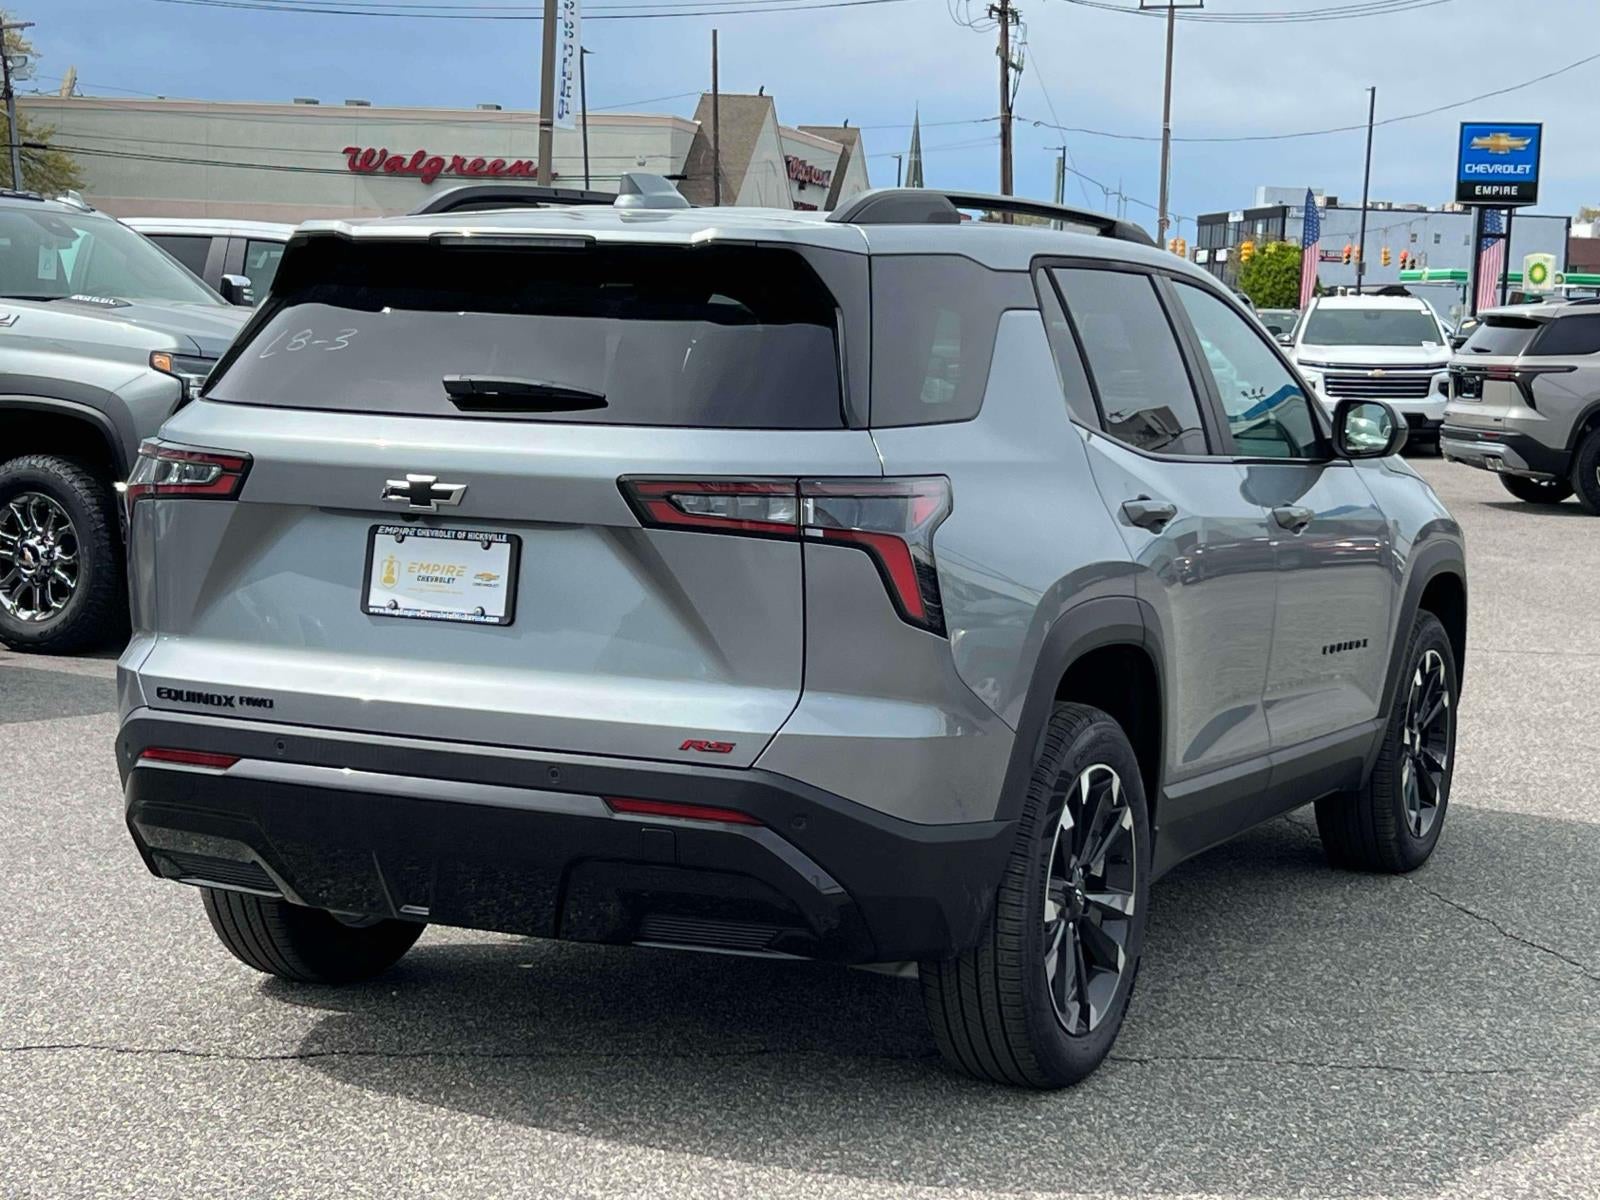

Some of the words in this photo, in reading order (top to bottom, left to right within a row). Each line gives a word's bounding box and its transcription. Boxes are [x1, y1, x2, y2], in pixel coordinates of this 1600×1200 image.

[342, 146, 558, 184] Walgreen
[1464, 163, 1531, 174] CHEVROLET
[1474, 185, 1518, 196] EMPIRE
[377, 526, 417, 536] EMPIRE
[416, 529, 455, 539] CHEVROLET
[457, 531, 465, 539] OF
[467, 531, 508, 542] HICKSVILLE
[407, 561, 467, 577] EMPIRE
[416, 575, 456, 584] CHEVROLET
[156, 686, 235, 708] EQUINOX
[678, 739, 736, 753] RS
